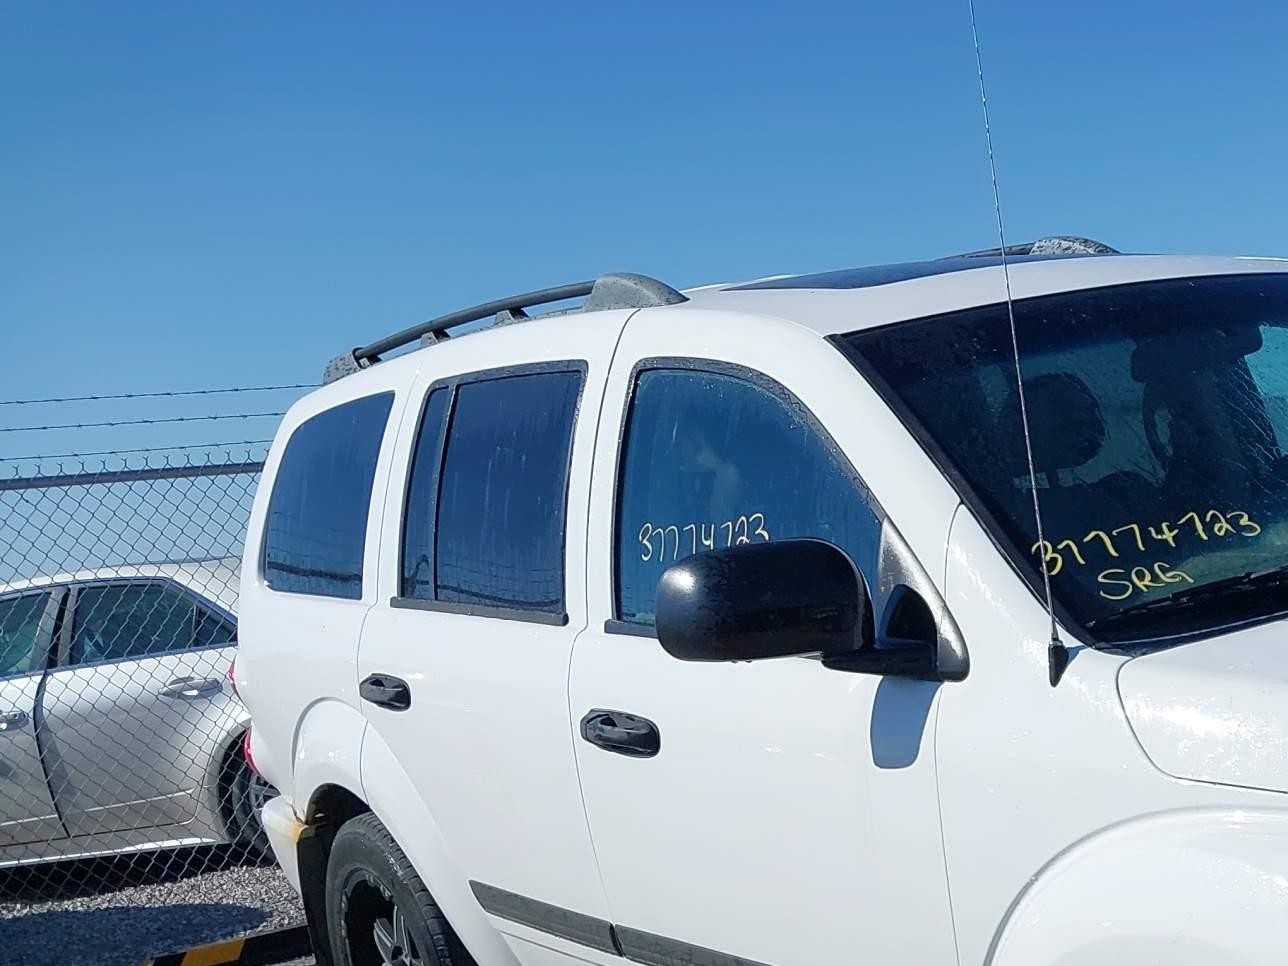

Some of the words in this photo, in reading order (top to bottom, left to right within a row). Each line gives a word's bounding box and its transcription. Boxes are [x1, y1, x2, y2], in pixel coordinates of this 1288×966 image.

[638, 512, 769, 563] 37774723
[1031, 509, 1261, 575] 37774723
[1097, 561, 1194, 600] SRG
